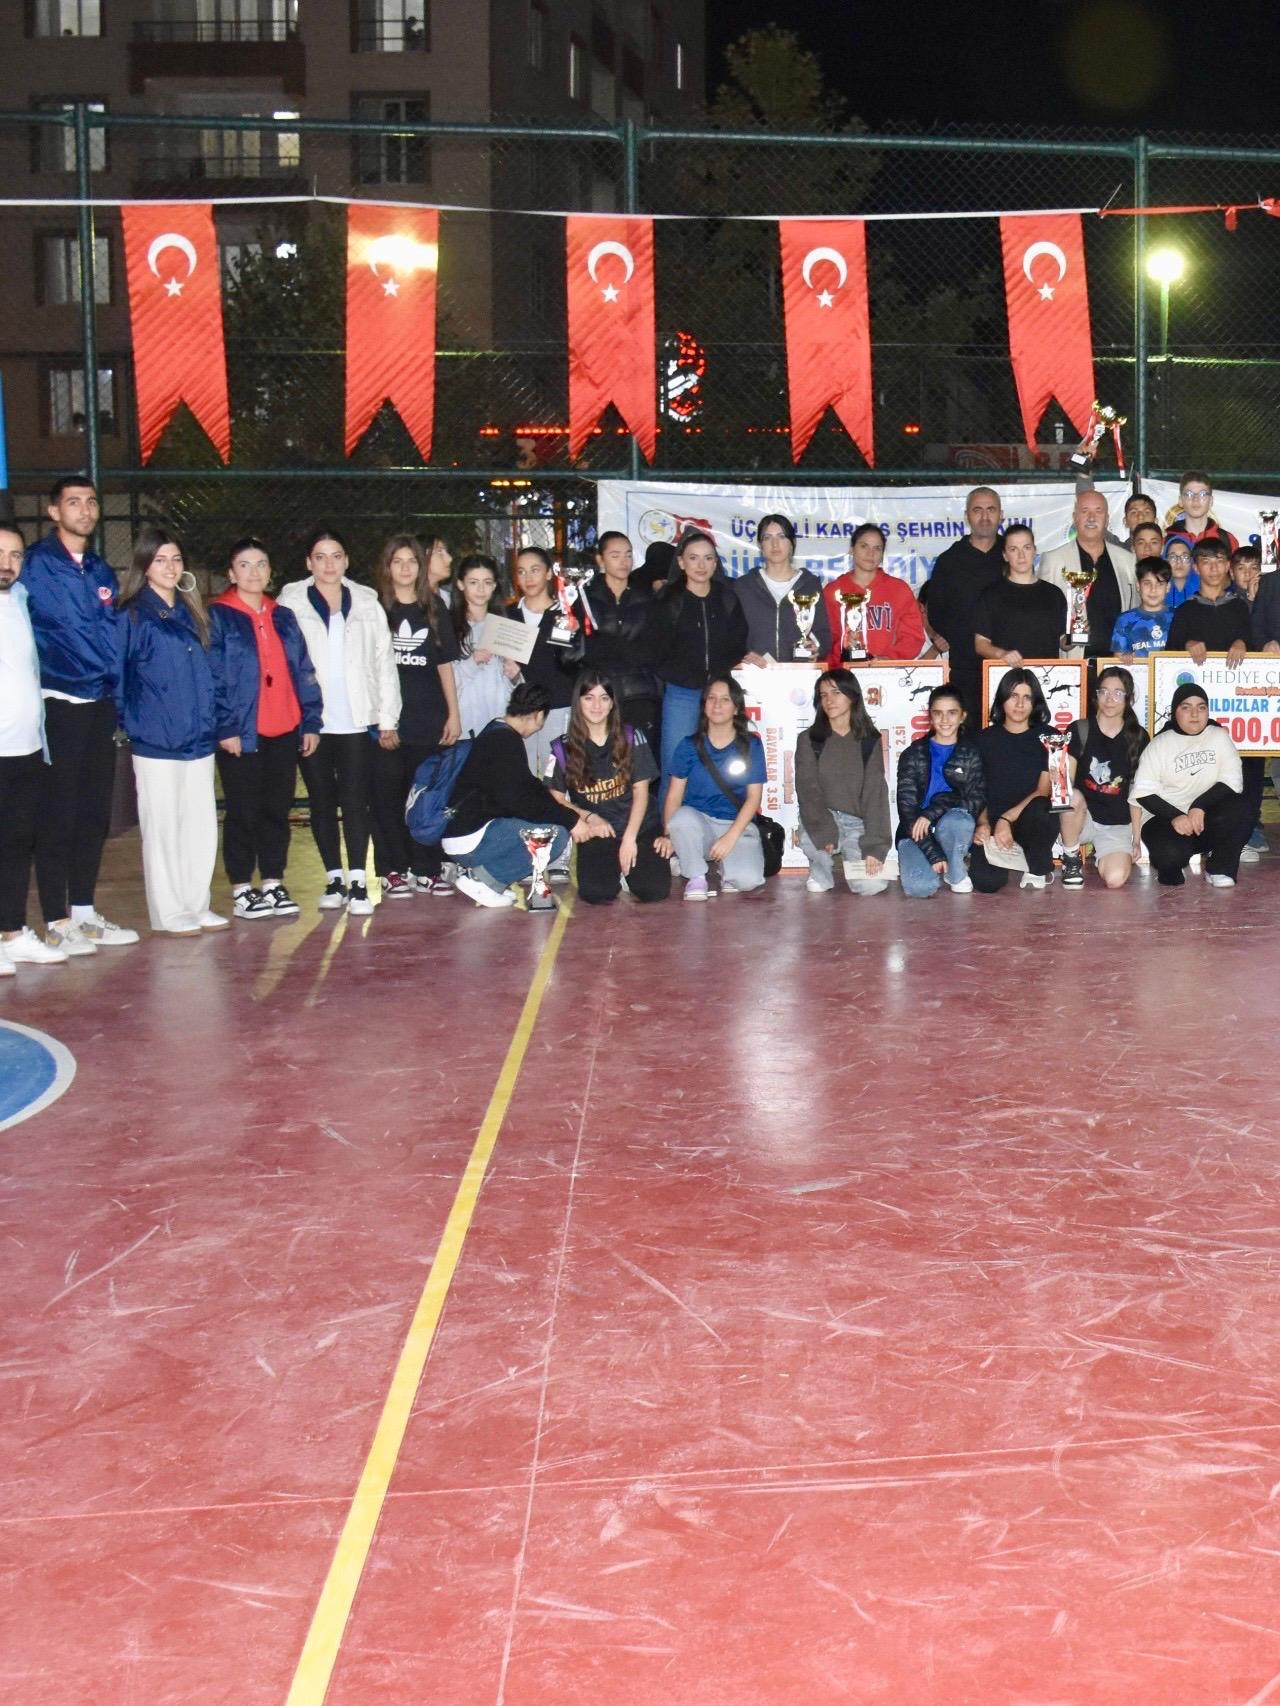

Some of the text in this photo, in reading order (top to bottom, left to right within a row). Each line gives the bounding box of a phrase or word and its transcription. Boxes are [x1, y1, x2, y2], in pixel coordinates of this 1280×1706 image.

[897, 517, 965, 542] ŞEHRİN
[1202, 669, 1261, 684] HEDİYE
[1208, 698, 1269, 713] ILDIZLAR
